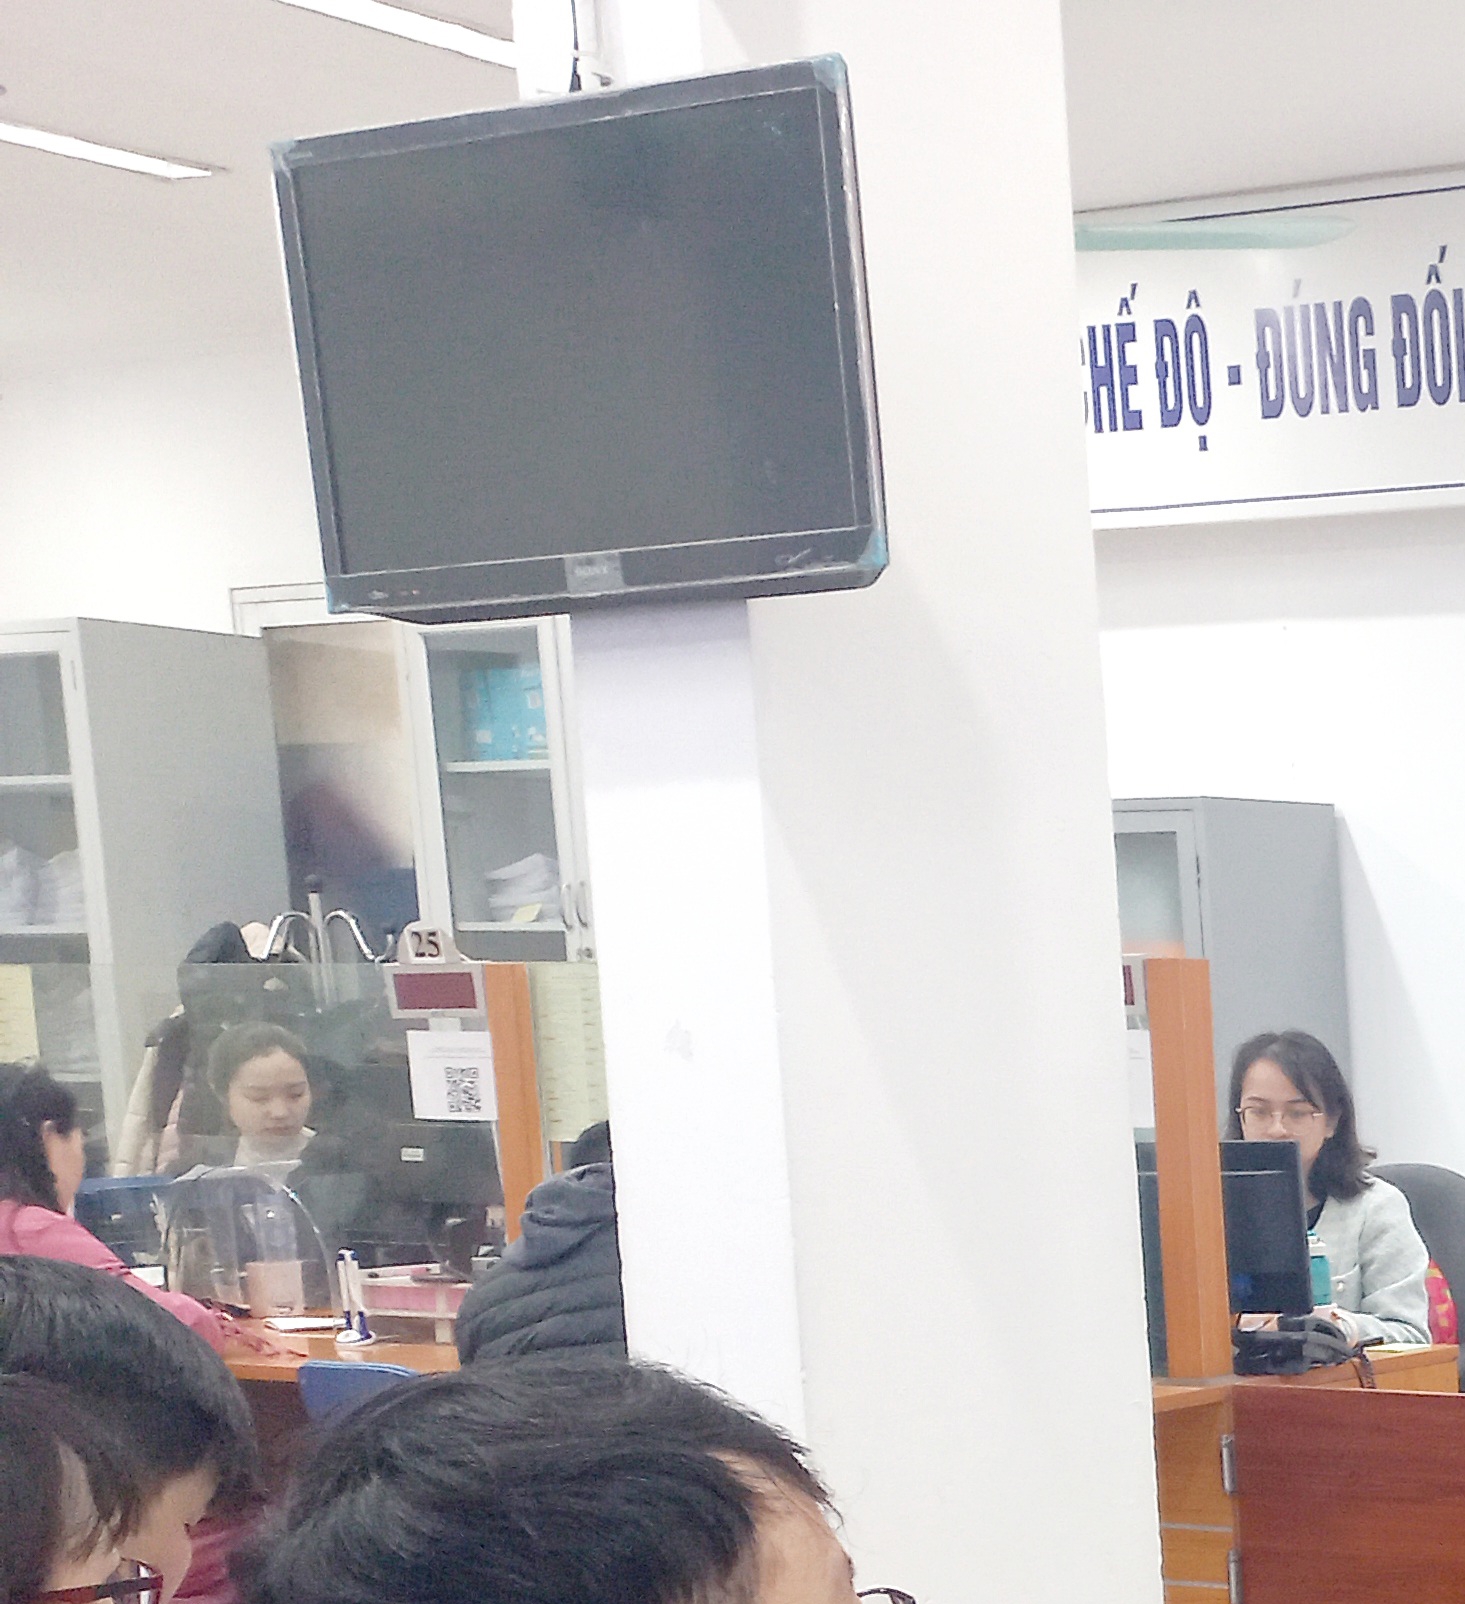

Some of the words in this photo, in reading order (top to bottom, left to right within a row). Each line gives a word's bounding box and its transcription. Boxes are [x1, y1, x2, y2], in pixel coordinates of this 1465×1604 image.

[1079, 282, 1144, 434] HẾ
[1152, 289, 1212, 452] ĐỘ
[1254, 278, 1380, 420] ĐÚNG
[410, 930, 441, 958] 25
